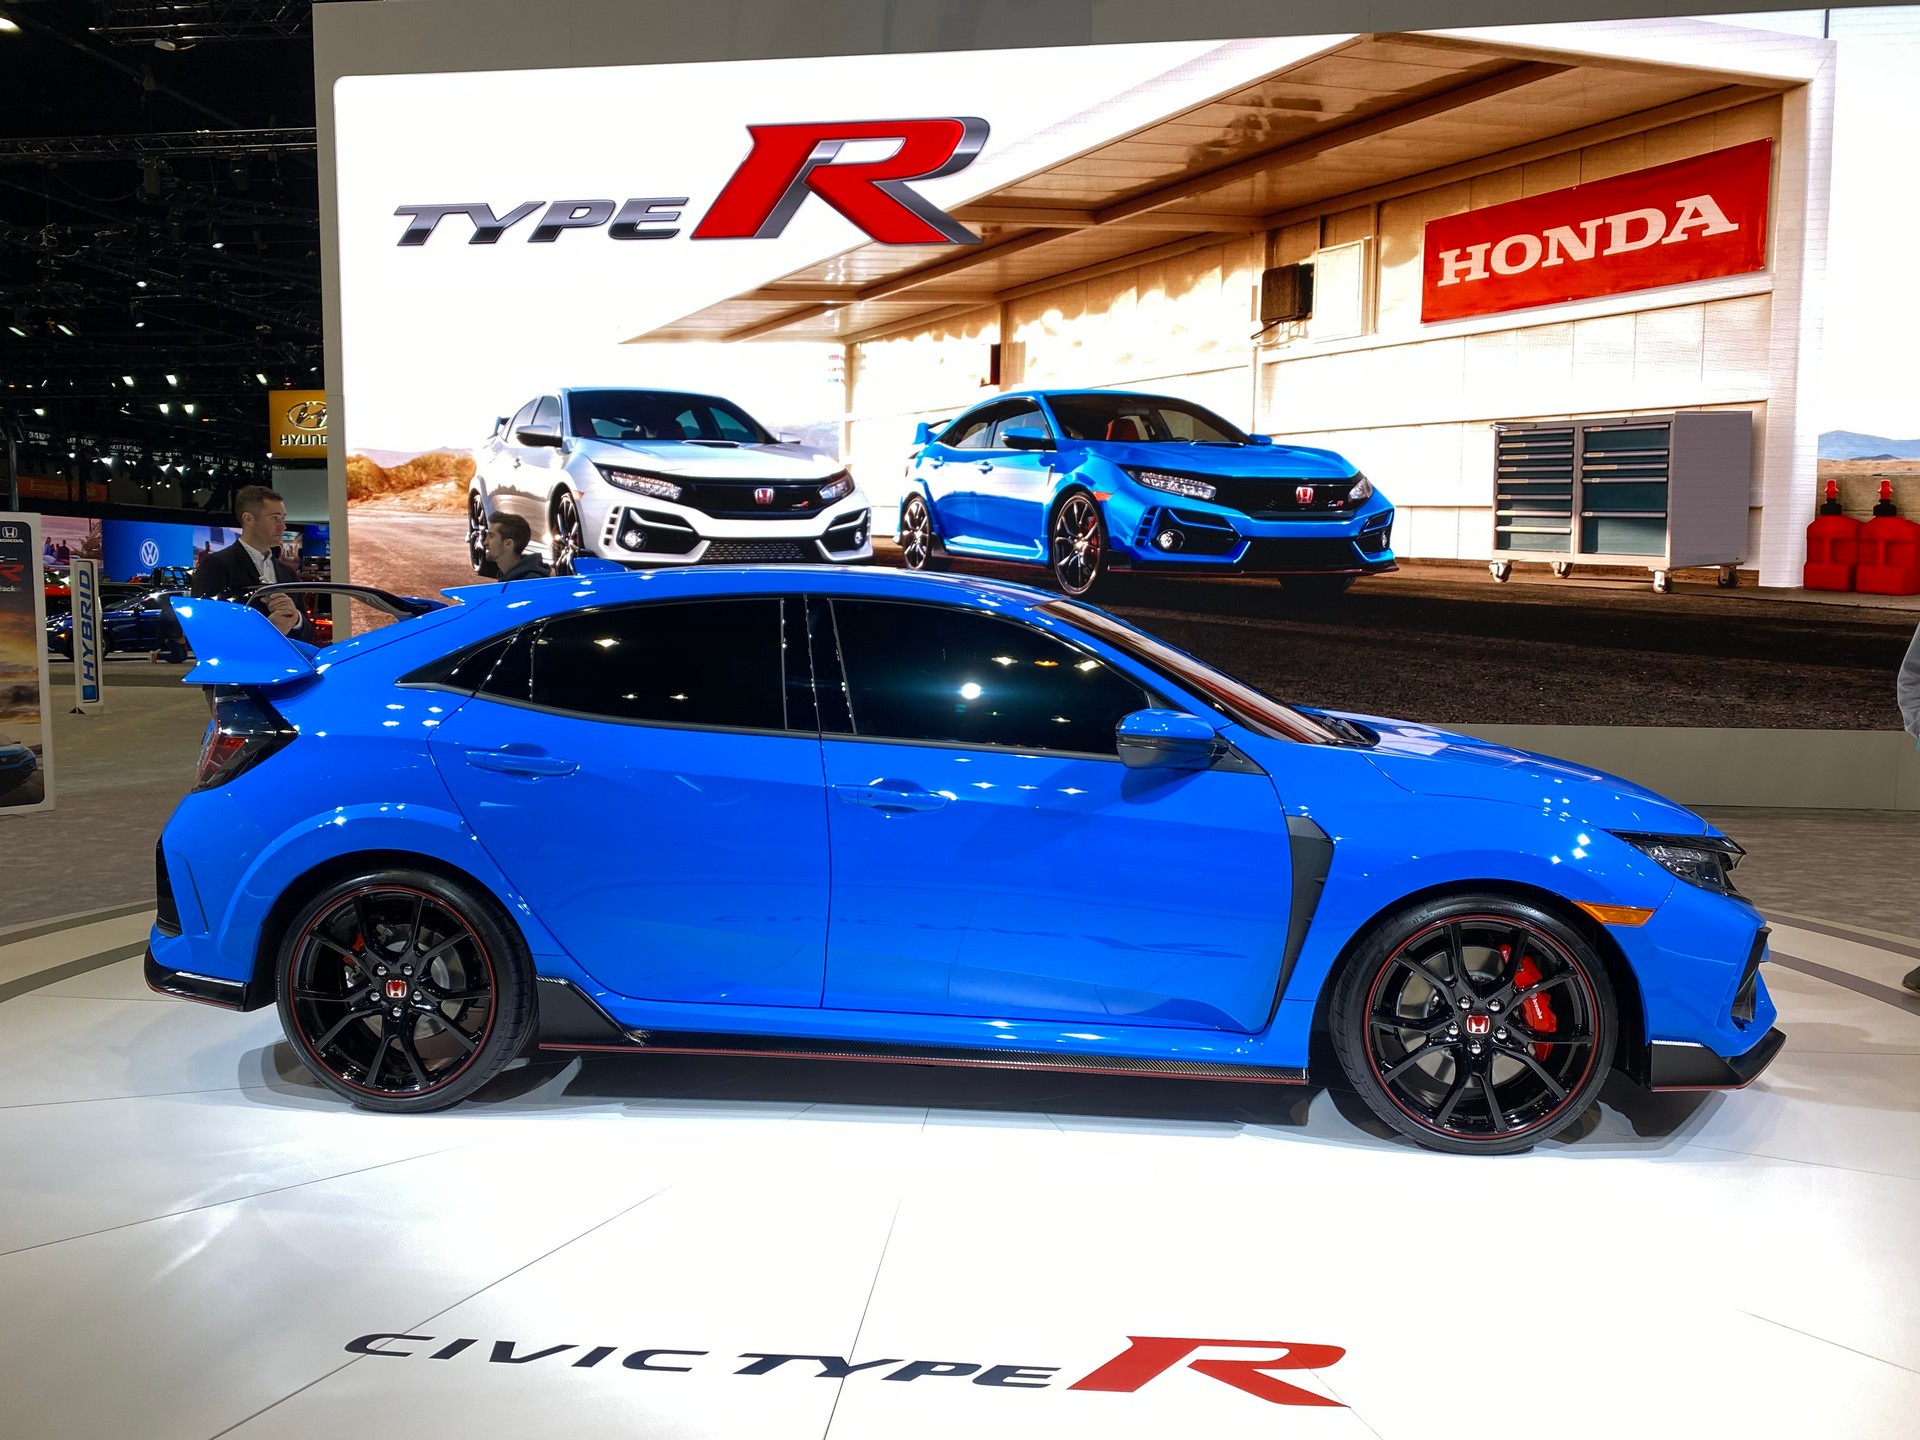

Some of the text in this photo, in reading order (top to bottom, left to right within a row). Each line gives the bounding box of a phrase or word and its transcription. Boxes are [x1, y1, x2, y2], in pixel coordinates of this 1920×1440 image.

[393, 116, 990, 246] TYPE R
[1437, 194, 1739, 287] HONDA
[79, 570, 95, 682] HYBRID
[344, 1333, 1352, 1408] CIVIC TYPE R
